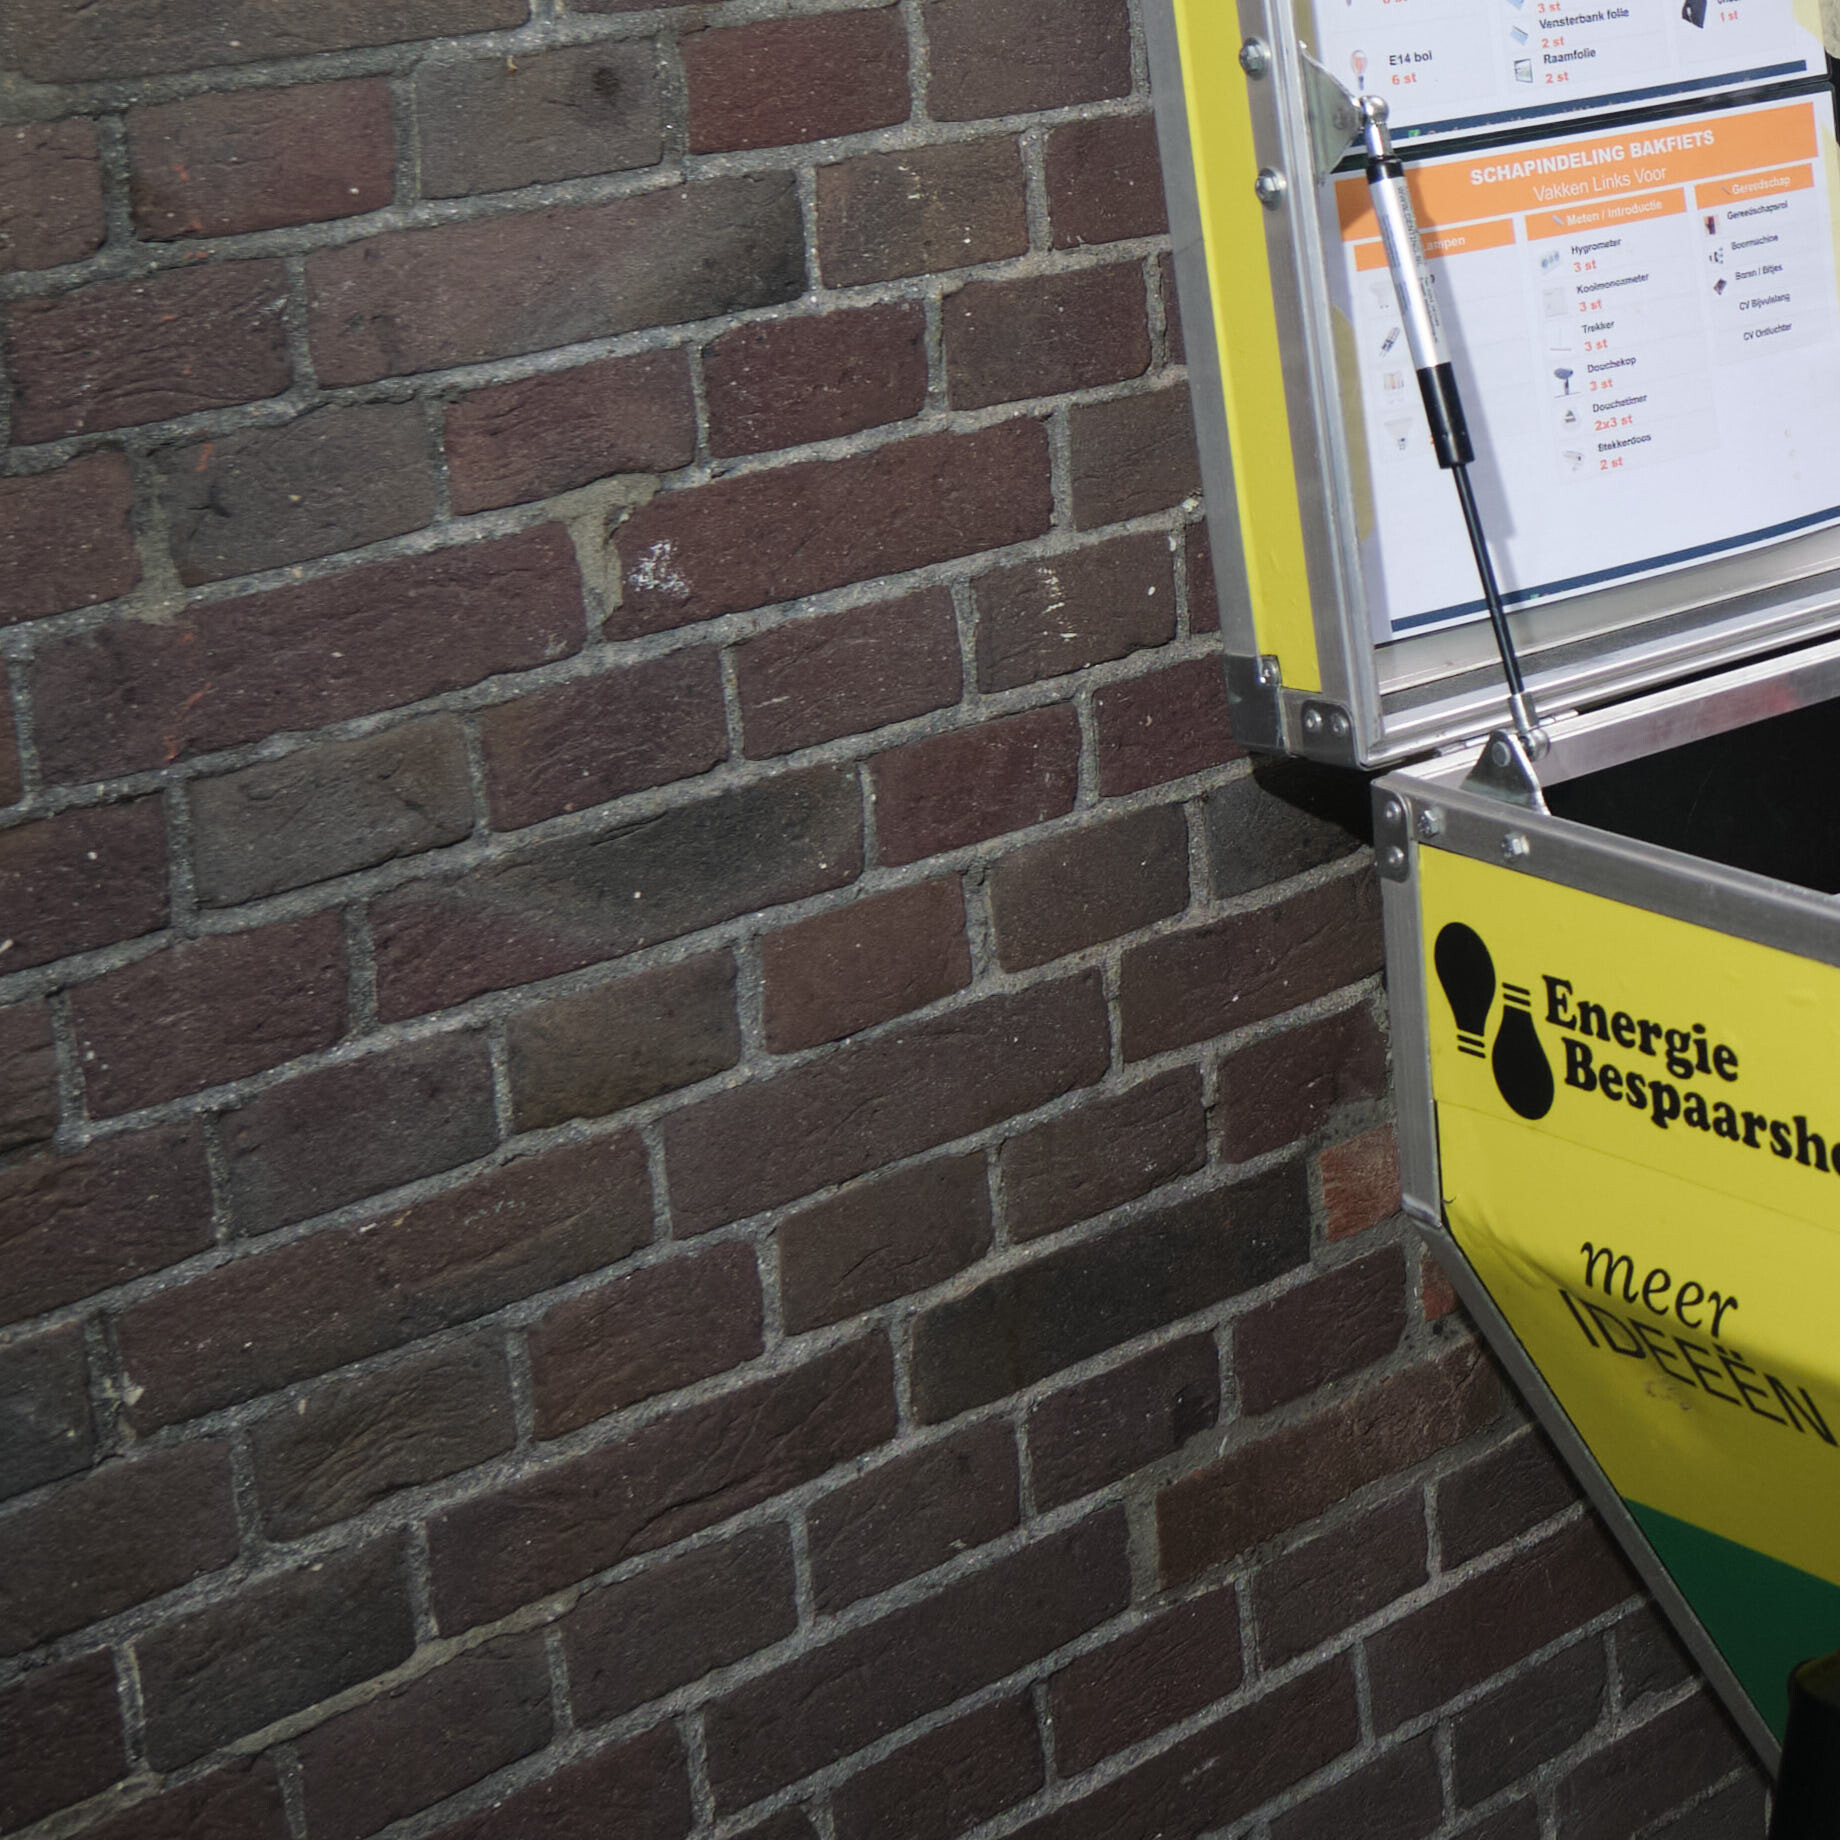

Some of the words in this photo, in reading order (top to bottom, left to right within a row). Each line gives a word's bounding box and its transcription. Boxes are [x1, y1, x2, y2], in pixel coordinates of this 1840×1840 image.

[1537, 3, 1545, 14] 3
[1549, 1, 1561, 12] st
[1539, 11, 1605, 29] Vensterbank
[1606, 8, 1629, 20] folie
[1720, 12, 1725, 22] 1
[1728, 10, 1738, 21] st
[1541, 38, 1549, 49] 2
[1552, 36, 1564, 47] st
[1389, 53, 1411, 66] E14
[1414, 51, 1433, 62] bol
[1543, 49, 1596, 64] Raamfolie
[1391, 74, 1400, 85] 6
[1403, 73, 1417, 84] st
[1545, 73, 1553, 84] 2
[1557, 72, 1569, 82] st
[1470, 145, 1625, 185] SCHAPINDELING
[1629, 130, 1714, 158] BAKFIETS
[1533, 181, 1589, 202] Vakken
[1592, 173, 1631, 192] Links
[1633, 168, 1666, 184] Voor
[1731, 177, 1791, 195] Gereedschap
[1566, 213, 1600, 226] Meten
[1607, 200, 1662, 218] Introductie
[1423, 236, 1467, 253] ampen
[1571, 239, 1621, 255] Hygrometer
[1573, 261, 1582, 273] 3
[1584, 260, 1597, 271] st
[1579, 301, 1587, 312] 3
[1590, 299, 1602, 310] st
[1581, 321, 1615, 334] Trekker
[1584, 341, 1592, 352] 3
[1595, 339, 1608, 350] st
[1587, 357, 1637, 373] Douchekop
[1589, 381, 1597, 392] 3
[1600, 378, 1613, 389] st
[1594, 417, 1618, 432] 2x3
[1621, 415, 1633, 425] st
[1600, 459, 1608, 471] 2
[1611, 457, 1623, 468] st
[1542, 975, 1739, 1082] Energie
[1580, 1241, 1739, 1338] meer
[1560, 1289, 1839, 1449] IDEEËN
